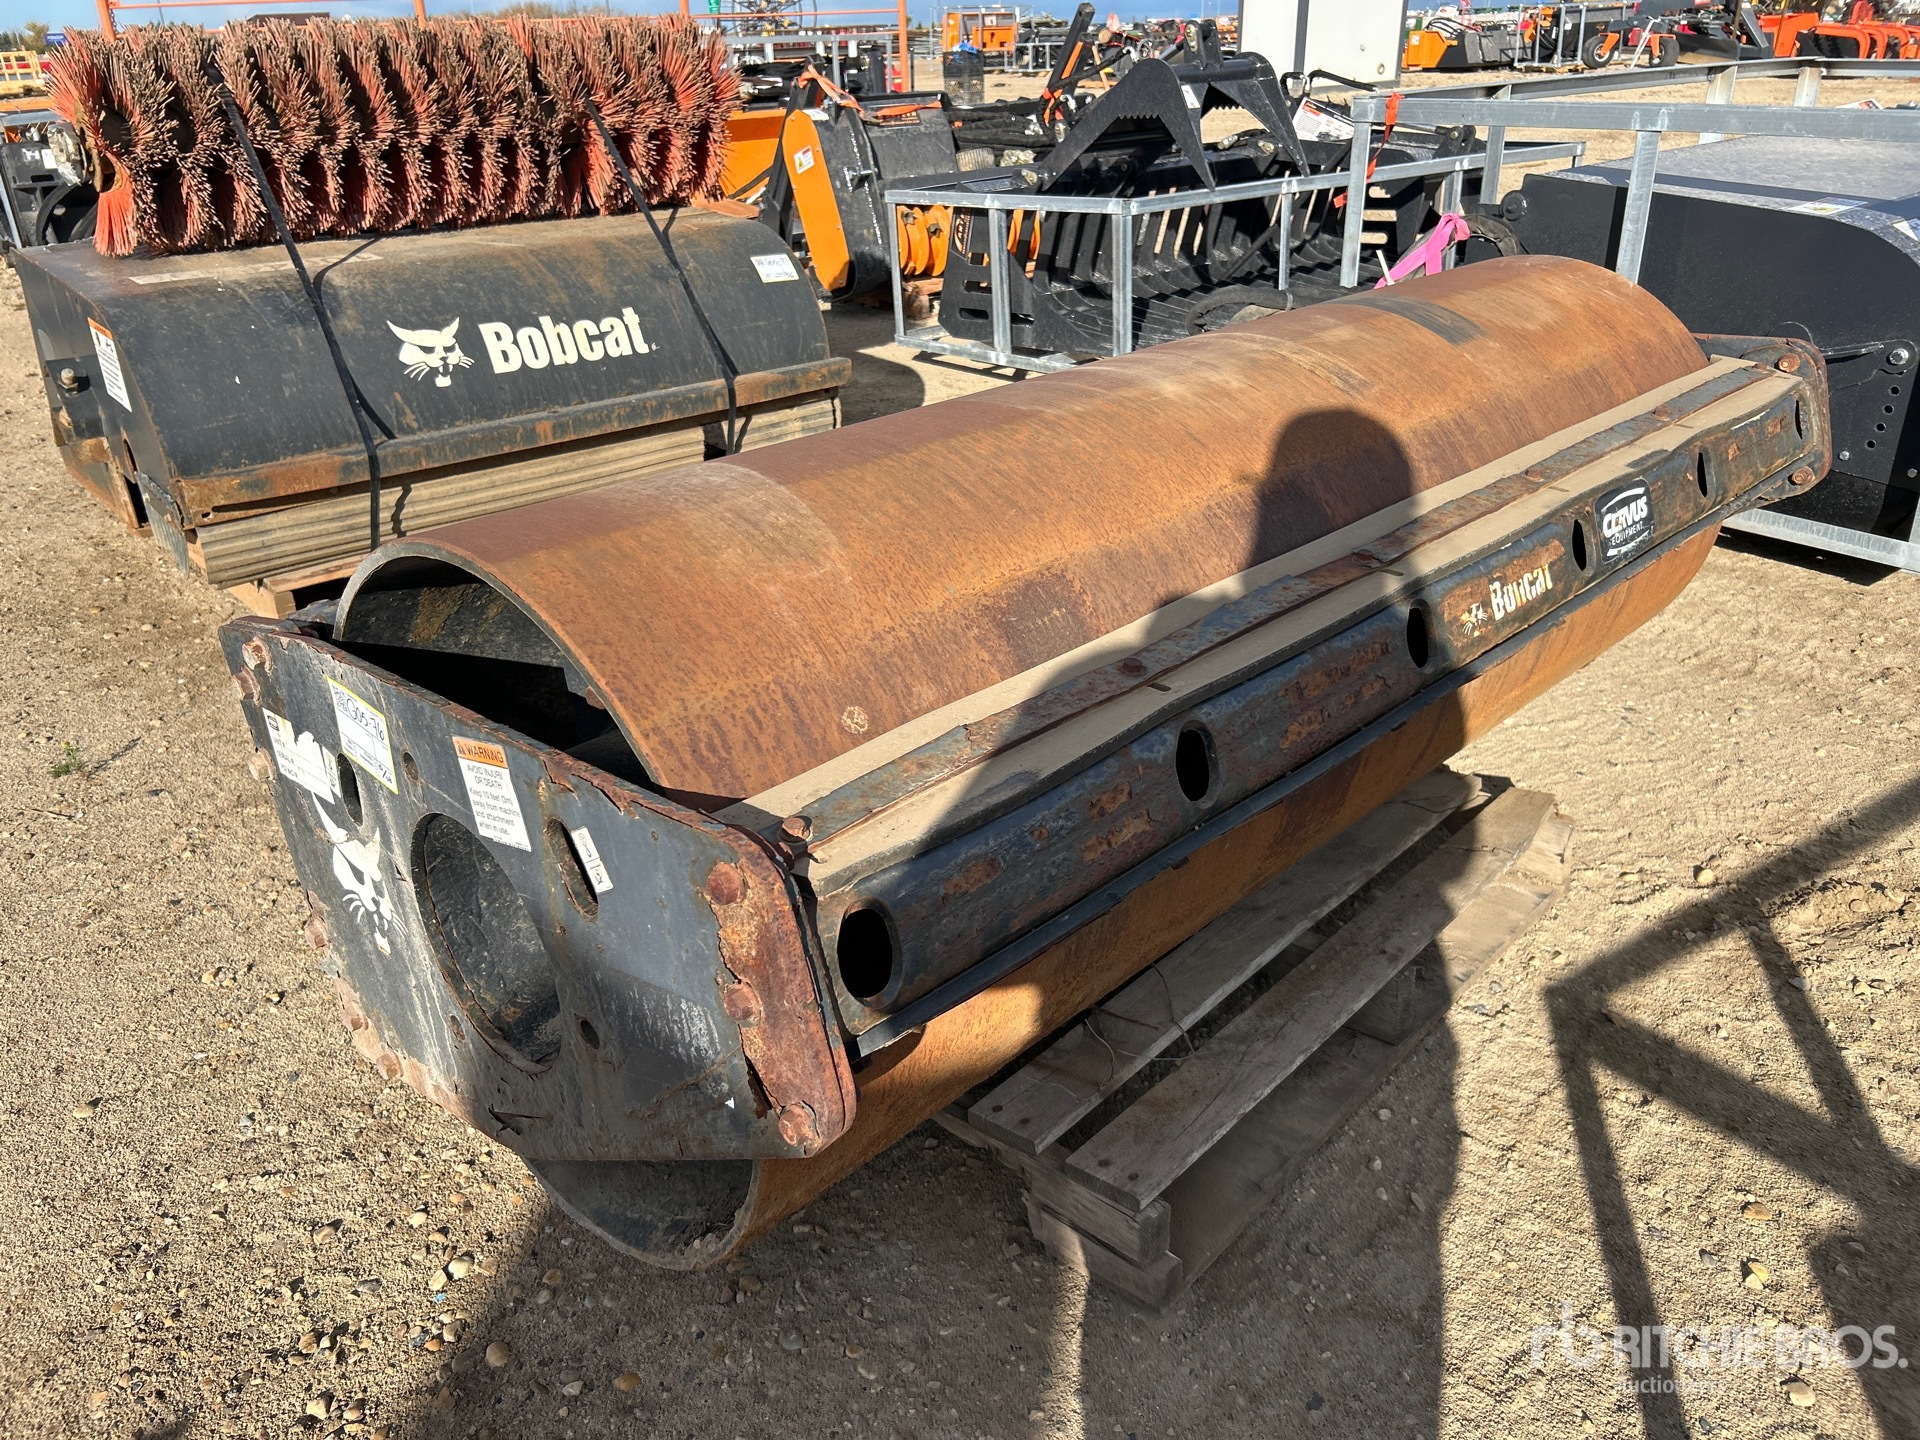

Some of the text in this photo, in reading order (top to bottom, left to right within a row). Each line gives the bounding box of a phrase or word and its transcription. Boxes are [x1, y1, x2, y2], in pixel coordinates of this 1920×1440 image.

[478, 306, 650, 375] Bobcat
[1603, 495, 1648, 539] CERVUS
[1612, 520, 1644, 546] EQUIPMENT
[464, 743, 504, 764] WARNING
[467, 763, 503, 780] AVOID INJURY
[474, 775, 503, 789] OR DEATH
